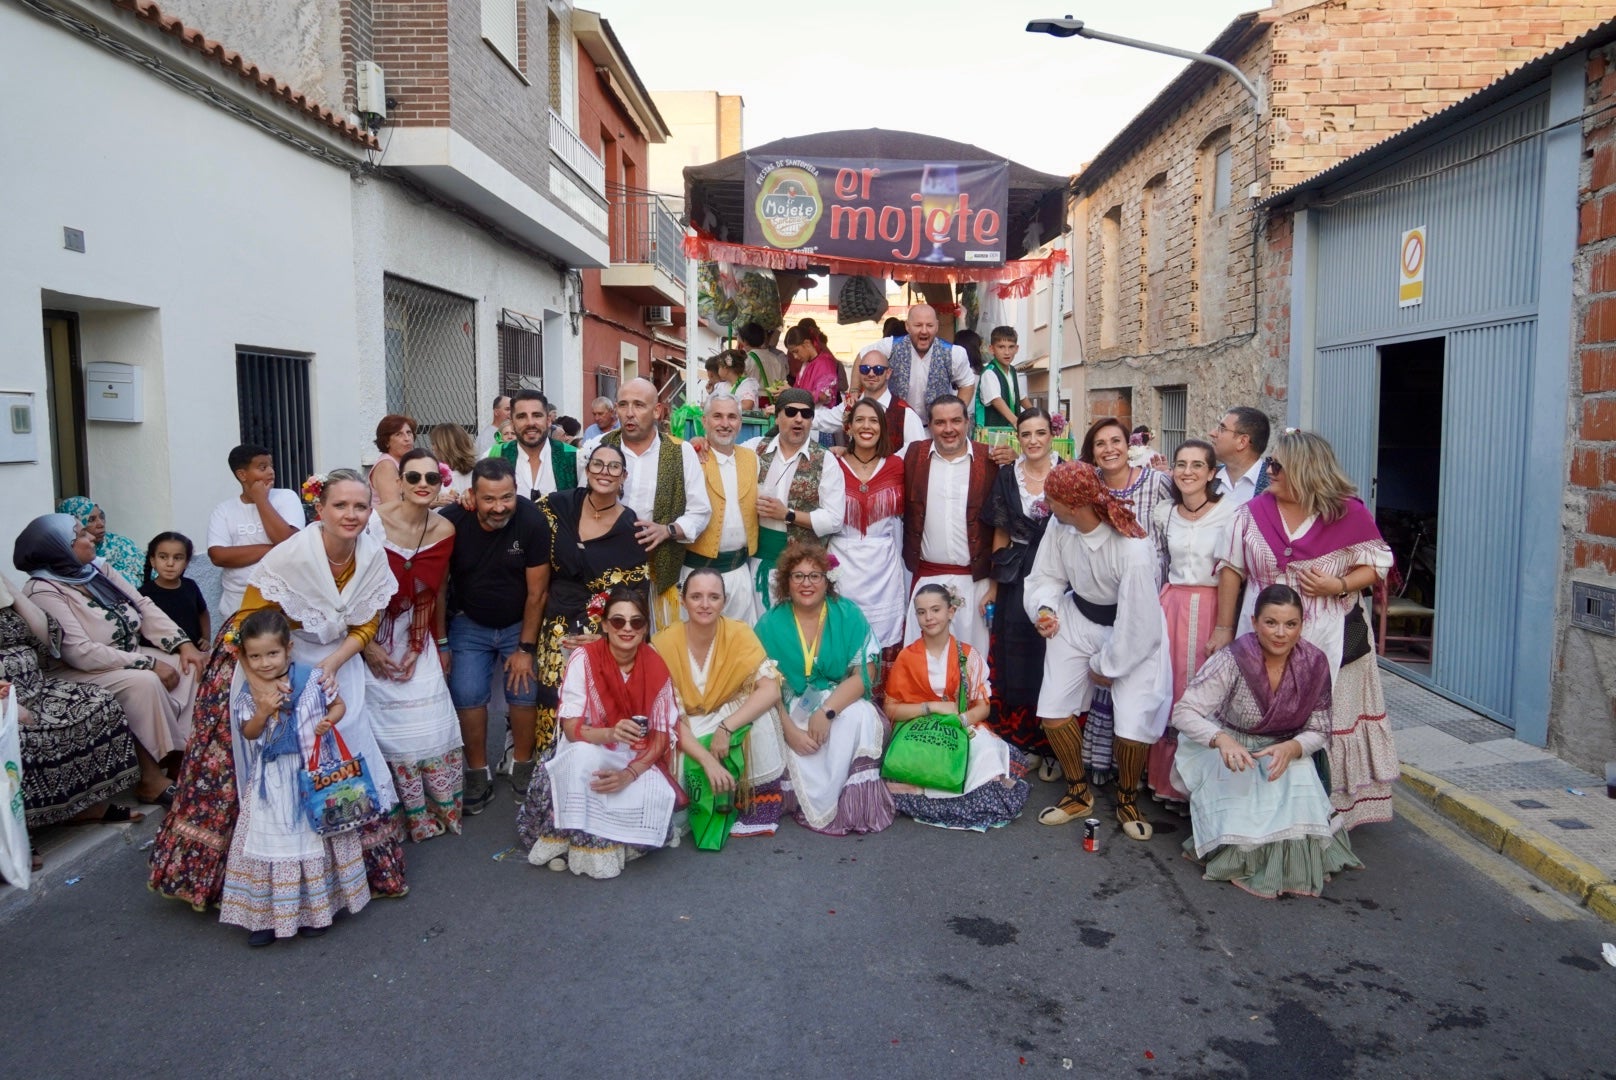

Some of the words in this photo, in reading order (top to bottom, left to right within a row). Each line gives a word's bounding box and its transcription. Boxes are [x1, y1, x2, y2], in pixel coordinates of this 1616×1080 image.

[834, 167, 880, 200] er
[765, 200, 814, 217] Mojete
[830, 193, 1000, 260] mojete
[238, 521, 264, 535] BOS
[909, 720, 959, 740] BELADO
[313, 759, 363, 792] ZOOM!
